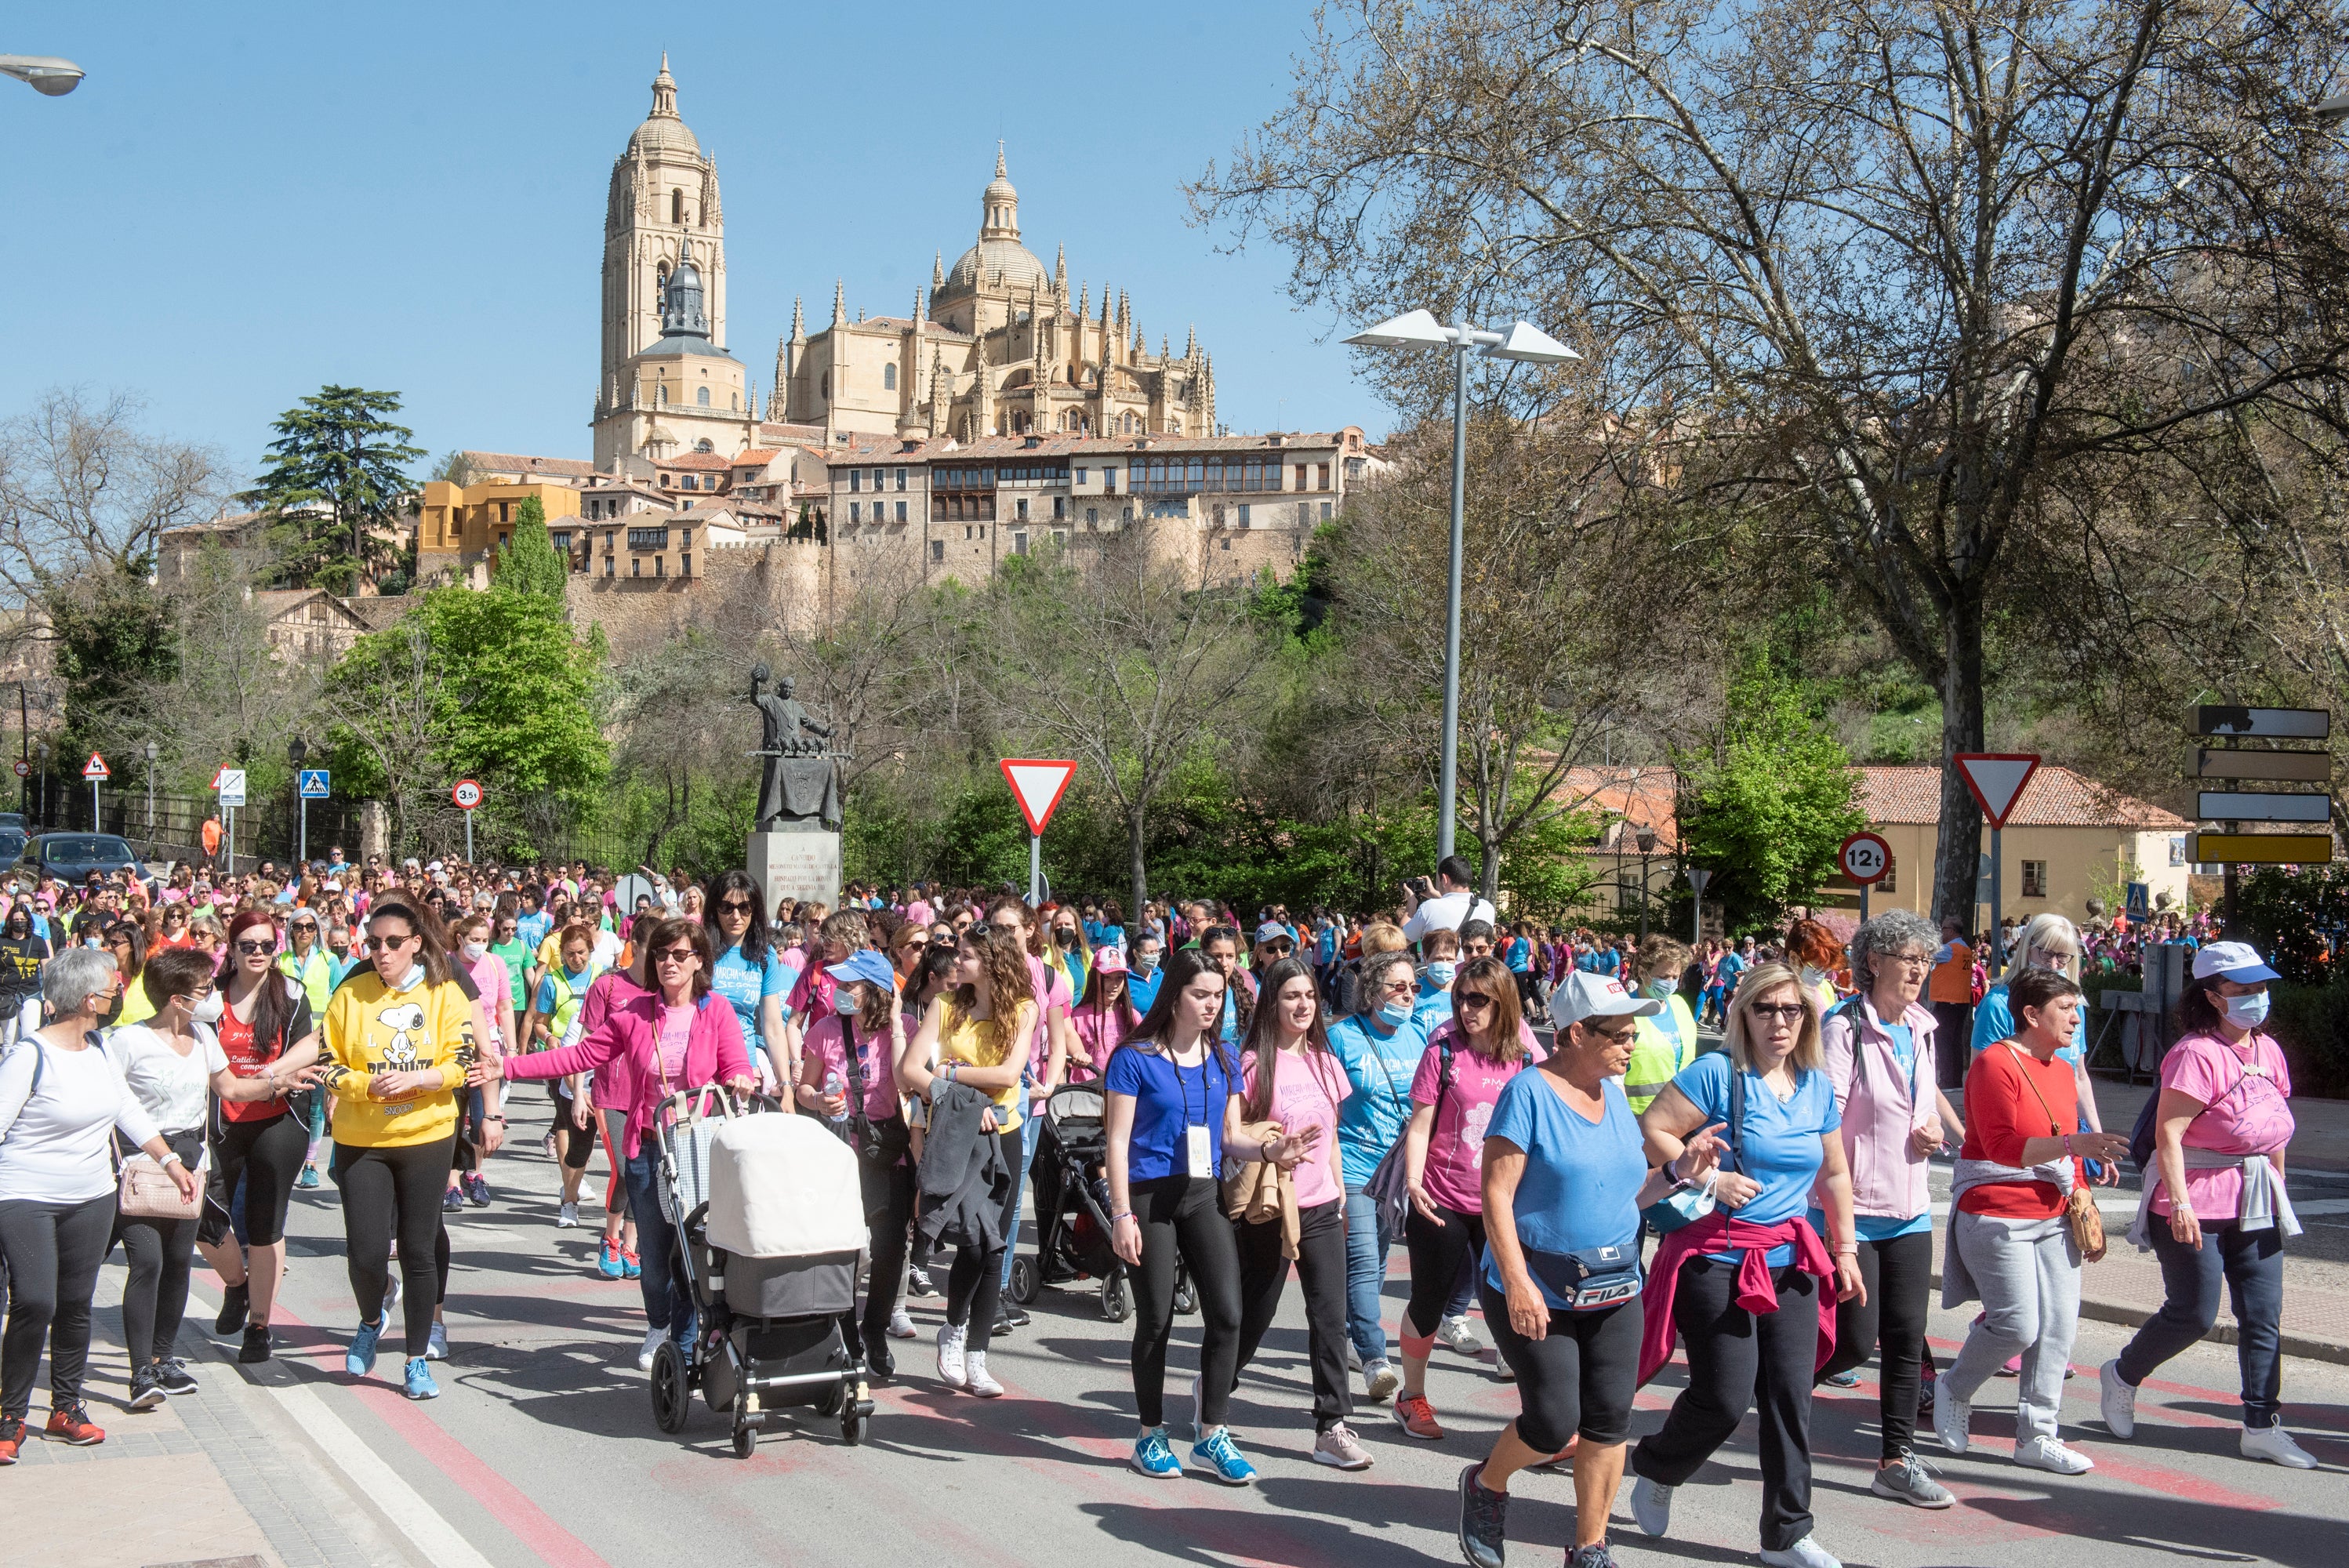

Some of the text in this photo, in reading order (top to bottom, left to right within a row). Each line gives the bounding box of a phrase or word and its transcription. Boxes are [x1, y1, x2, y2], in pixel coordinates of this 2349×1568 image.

[368, 1030, 432, 1047] L A
[384, 1102, 415, 1116] SNOOPY
[1583, 1286, 1630, 1305] FILA
